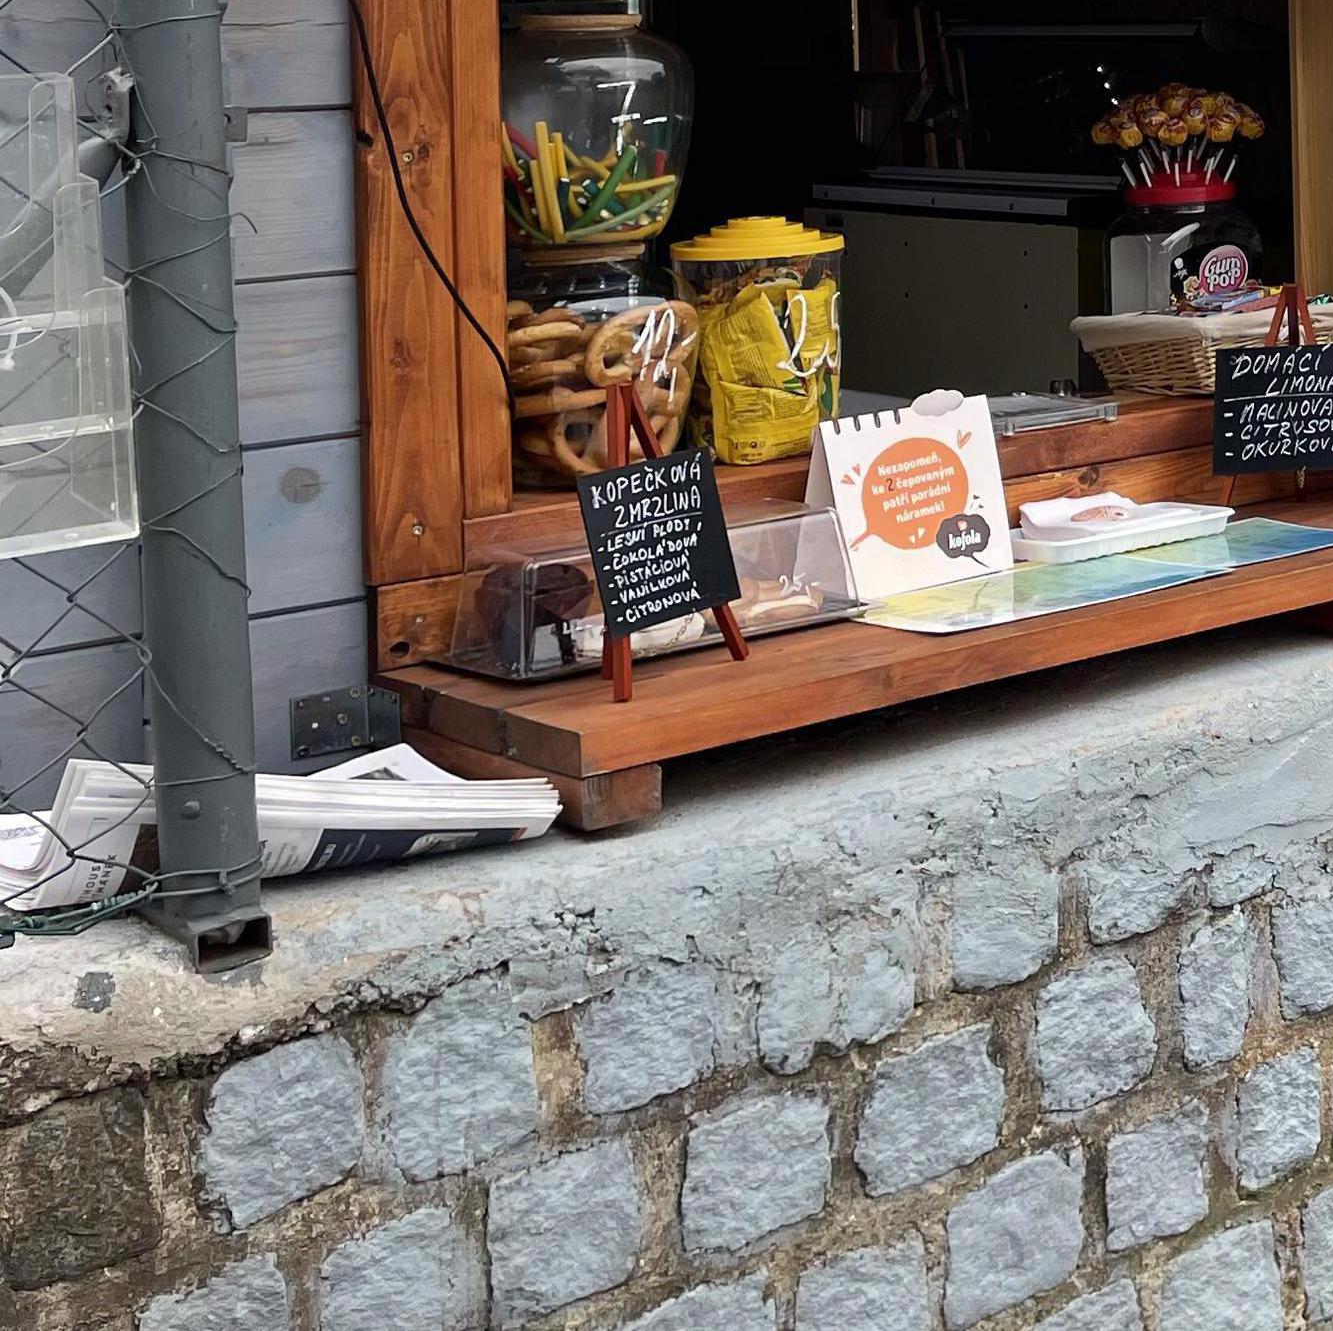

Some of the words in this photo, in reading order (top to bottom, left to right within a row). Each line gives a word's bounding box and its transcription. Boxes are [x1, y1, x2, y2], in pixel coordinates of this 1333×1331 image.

[1204, 256, 1241, 277] Gum
[1231, 344, 1331, 380] DOMÁCÍ
[871, 484, 885, 496] ke
[885, 478, 895, 492] 2
[896, 466, 955, 491] čepovaným
[882, 492, 909, 512] patří
[911, 483, 951, 505] parádní
[896, 501, 946, 523] náramek!
[606, 522, 648, 552] LESNÍ
[653, 518, 691, 538] PLODY
[948, 530, 982, 551] kofola
